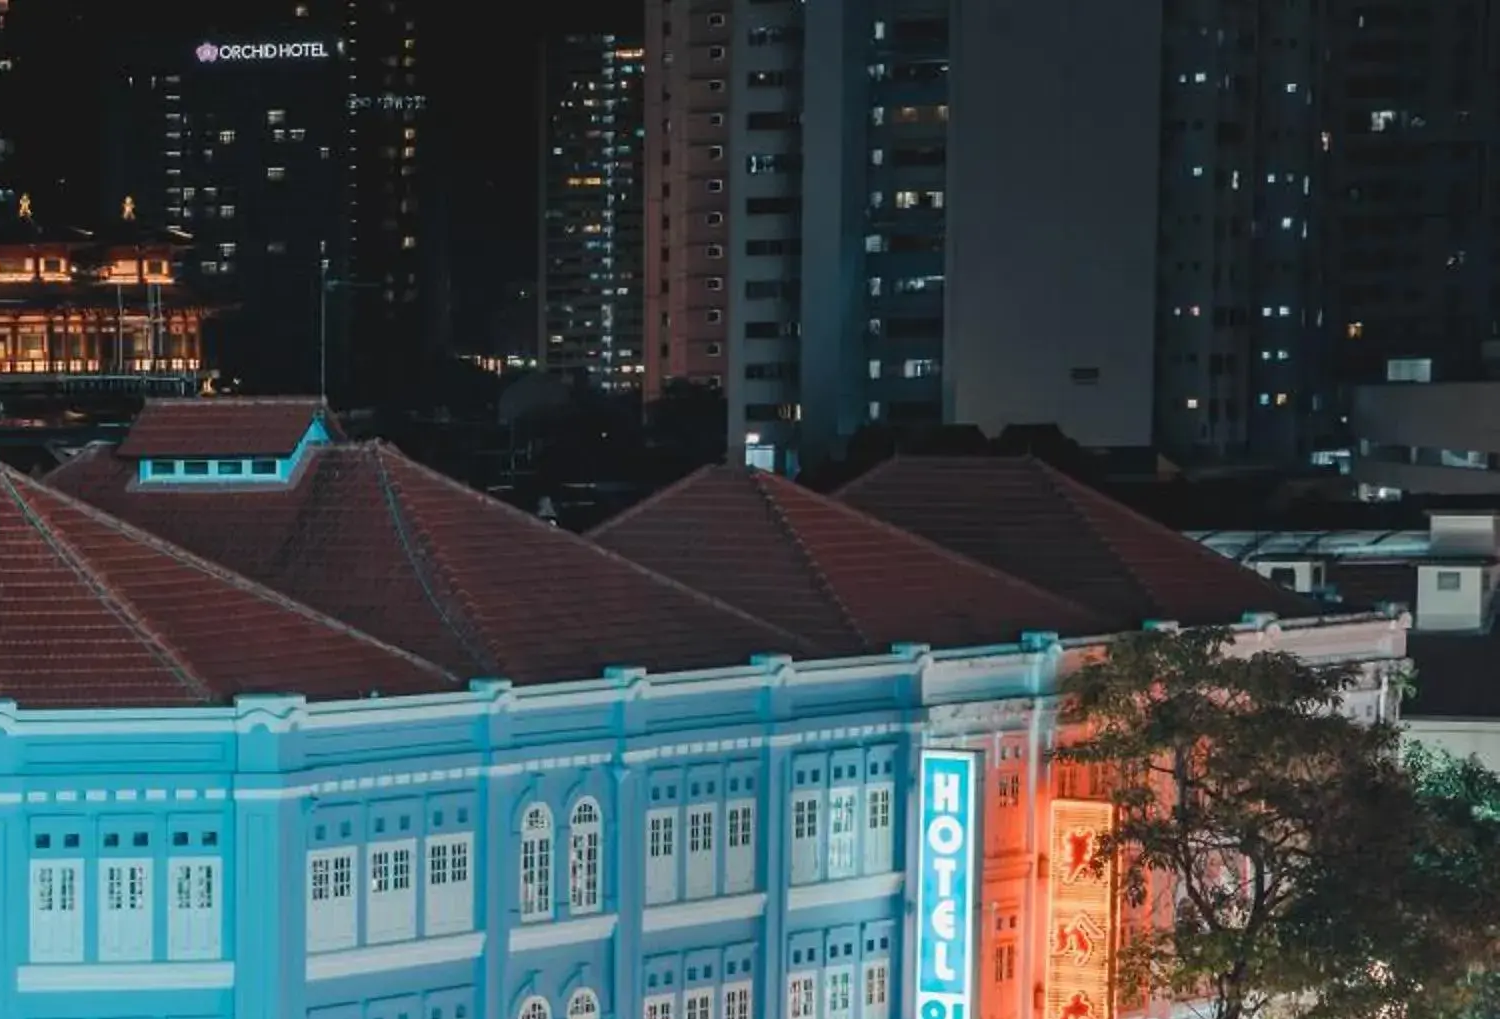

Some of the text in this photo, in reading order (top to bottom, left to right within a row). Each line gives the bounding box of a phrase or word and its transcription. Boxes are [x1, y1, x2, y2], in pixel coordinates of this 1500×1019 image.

[219, 42, 329, 59] ORCHID HOTEL
[927, 773, 964, 981] HOTEL
